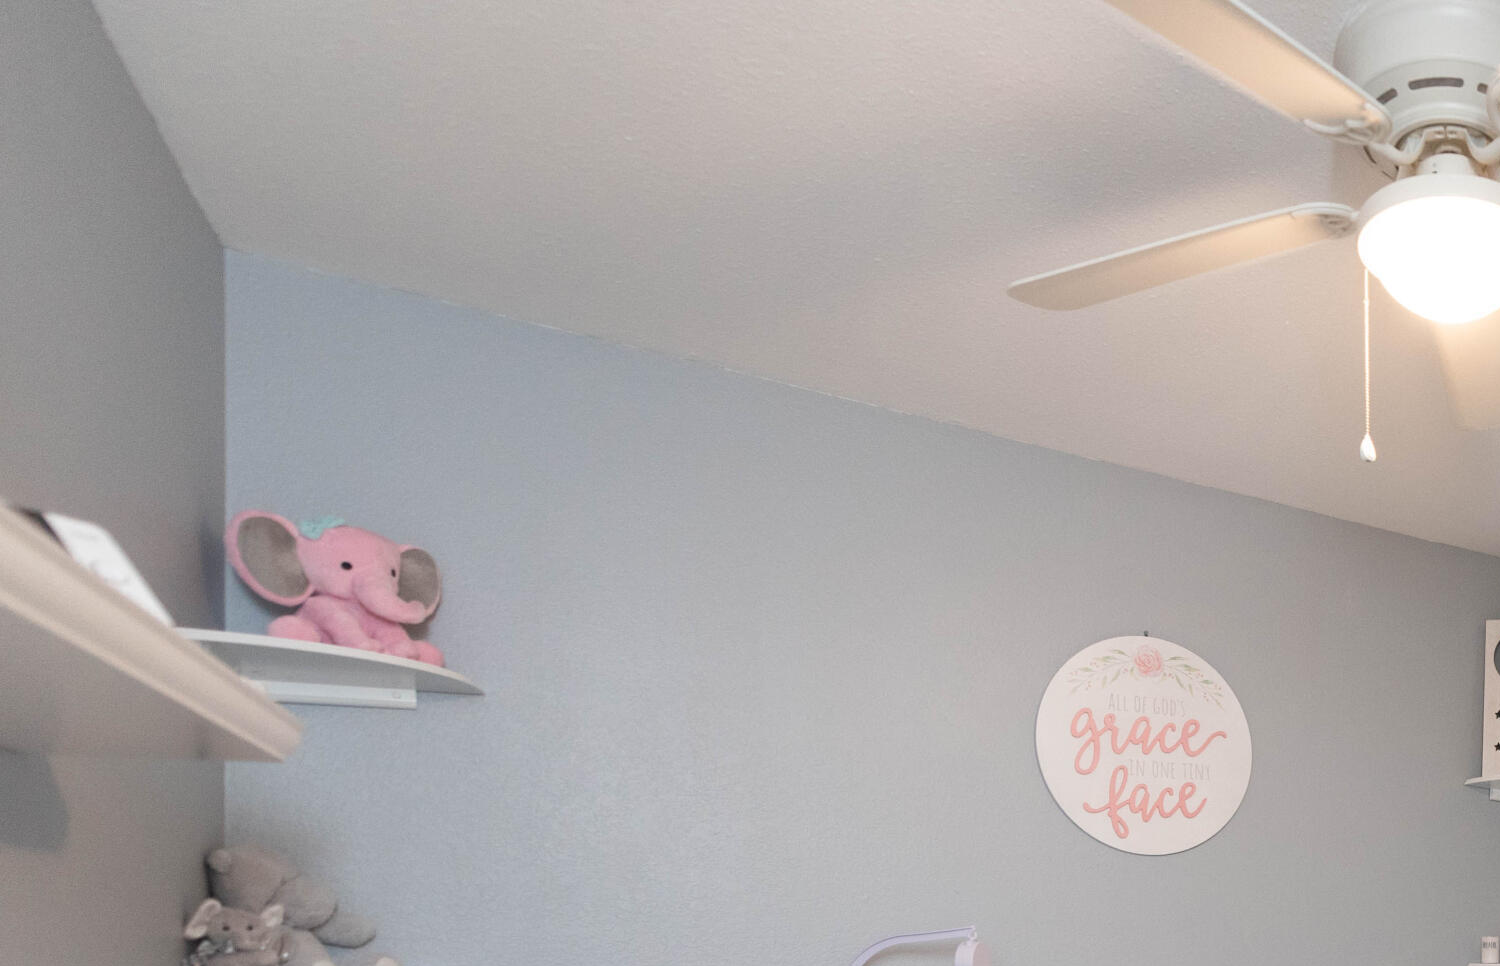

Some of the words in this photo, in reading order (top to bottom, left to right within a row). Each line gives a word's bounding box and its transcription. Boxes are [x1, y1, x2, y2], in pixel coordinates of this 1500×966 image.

[1108, 693, 1128, 712] ALL
[1134, 695, 1149, 713] OF
[1153, 697, 1186, 718] GOD'S
[1070, 707, 1228, 775] grace
[1128, 758, 1144, 777] IN
[1152, 760, 1176, 779] ONE
[1182, 762, 1211, 782] TINY
[1082, 765, 1208, 839] face
